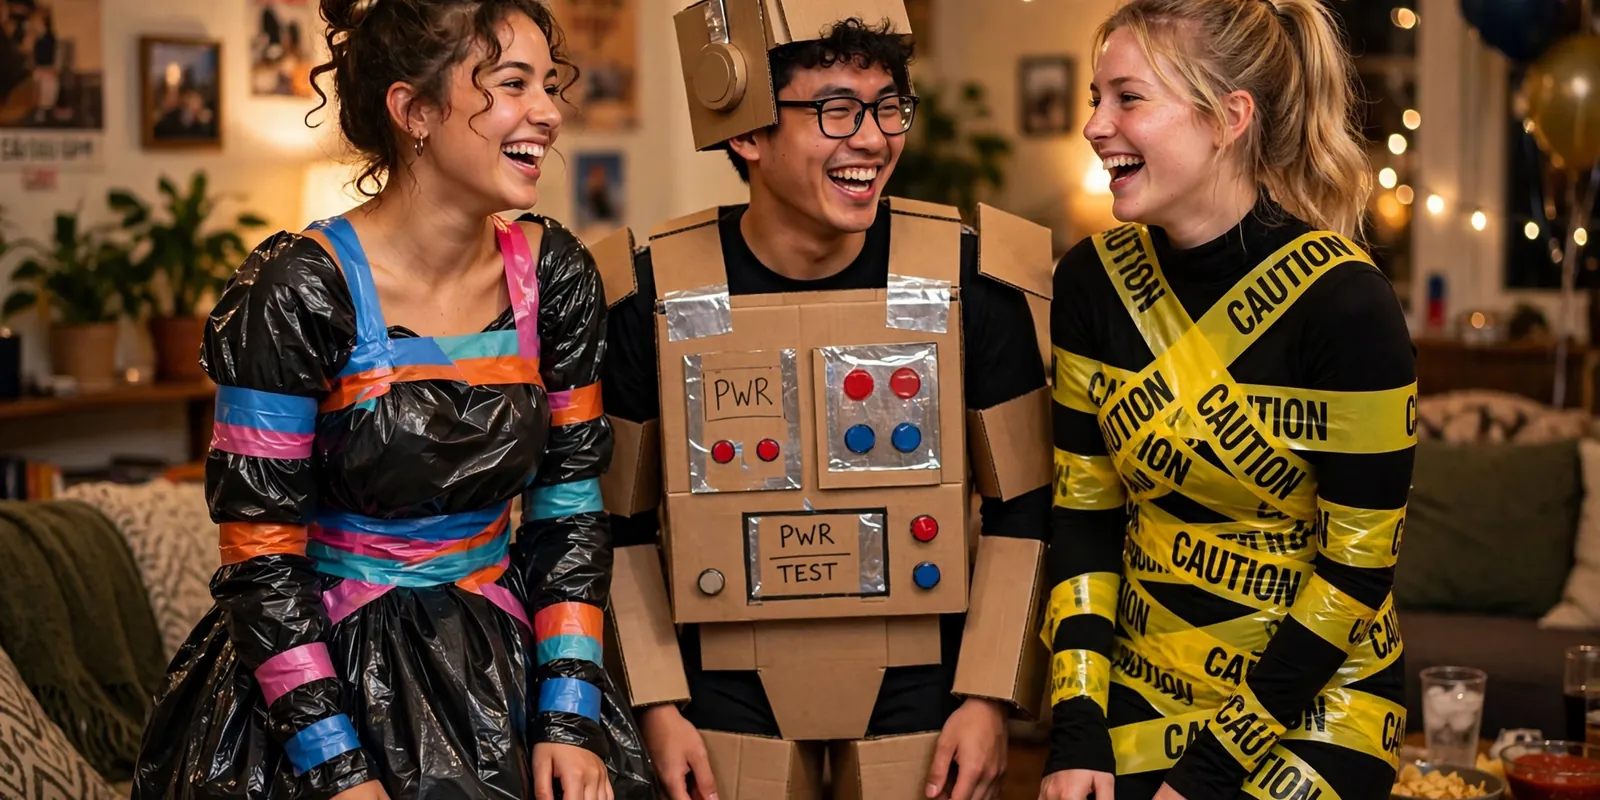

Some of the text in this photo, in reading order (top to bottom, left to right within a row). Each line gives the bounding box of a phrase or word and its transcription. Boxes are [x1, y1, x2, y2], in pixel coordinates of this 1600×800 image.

[1227, 235, 1355, 335] CAUTION
[714, 377, 774, 411] PWR
[1101, 370, 1175, 458] UTION
[1246, 395, 1327, 441] TION
[1197, 384, 1306, 500] CAUTION
[780, 523, 835, 548] PWR
[777, 562, 838, 583] TEST
[1172, 531, 1302, 607] CAUTION
